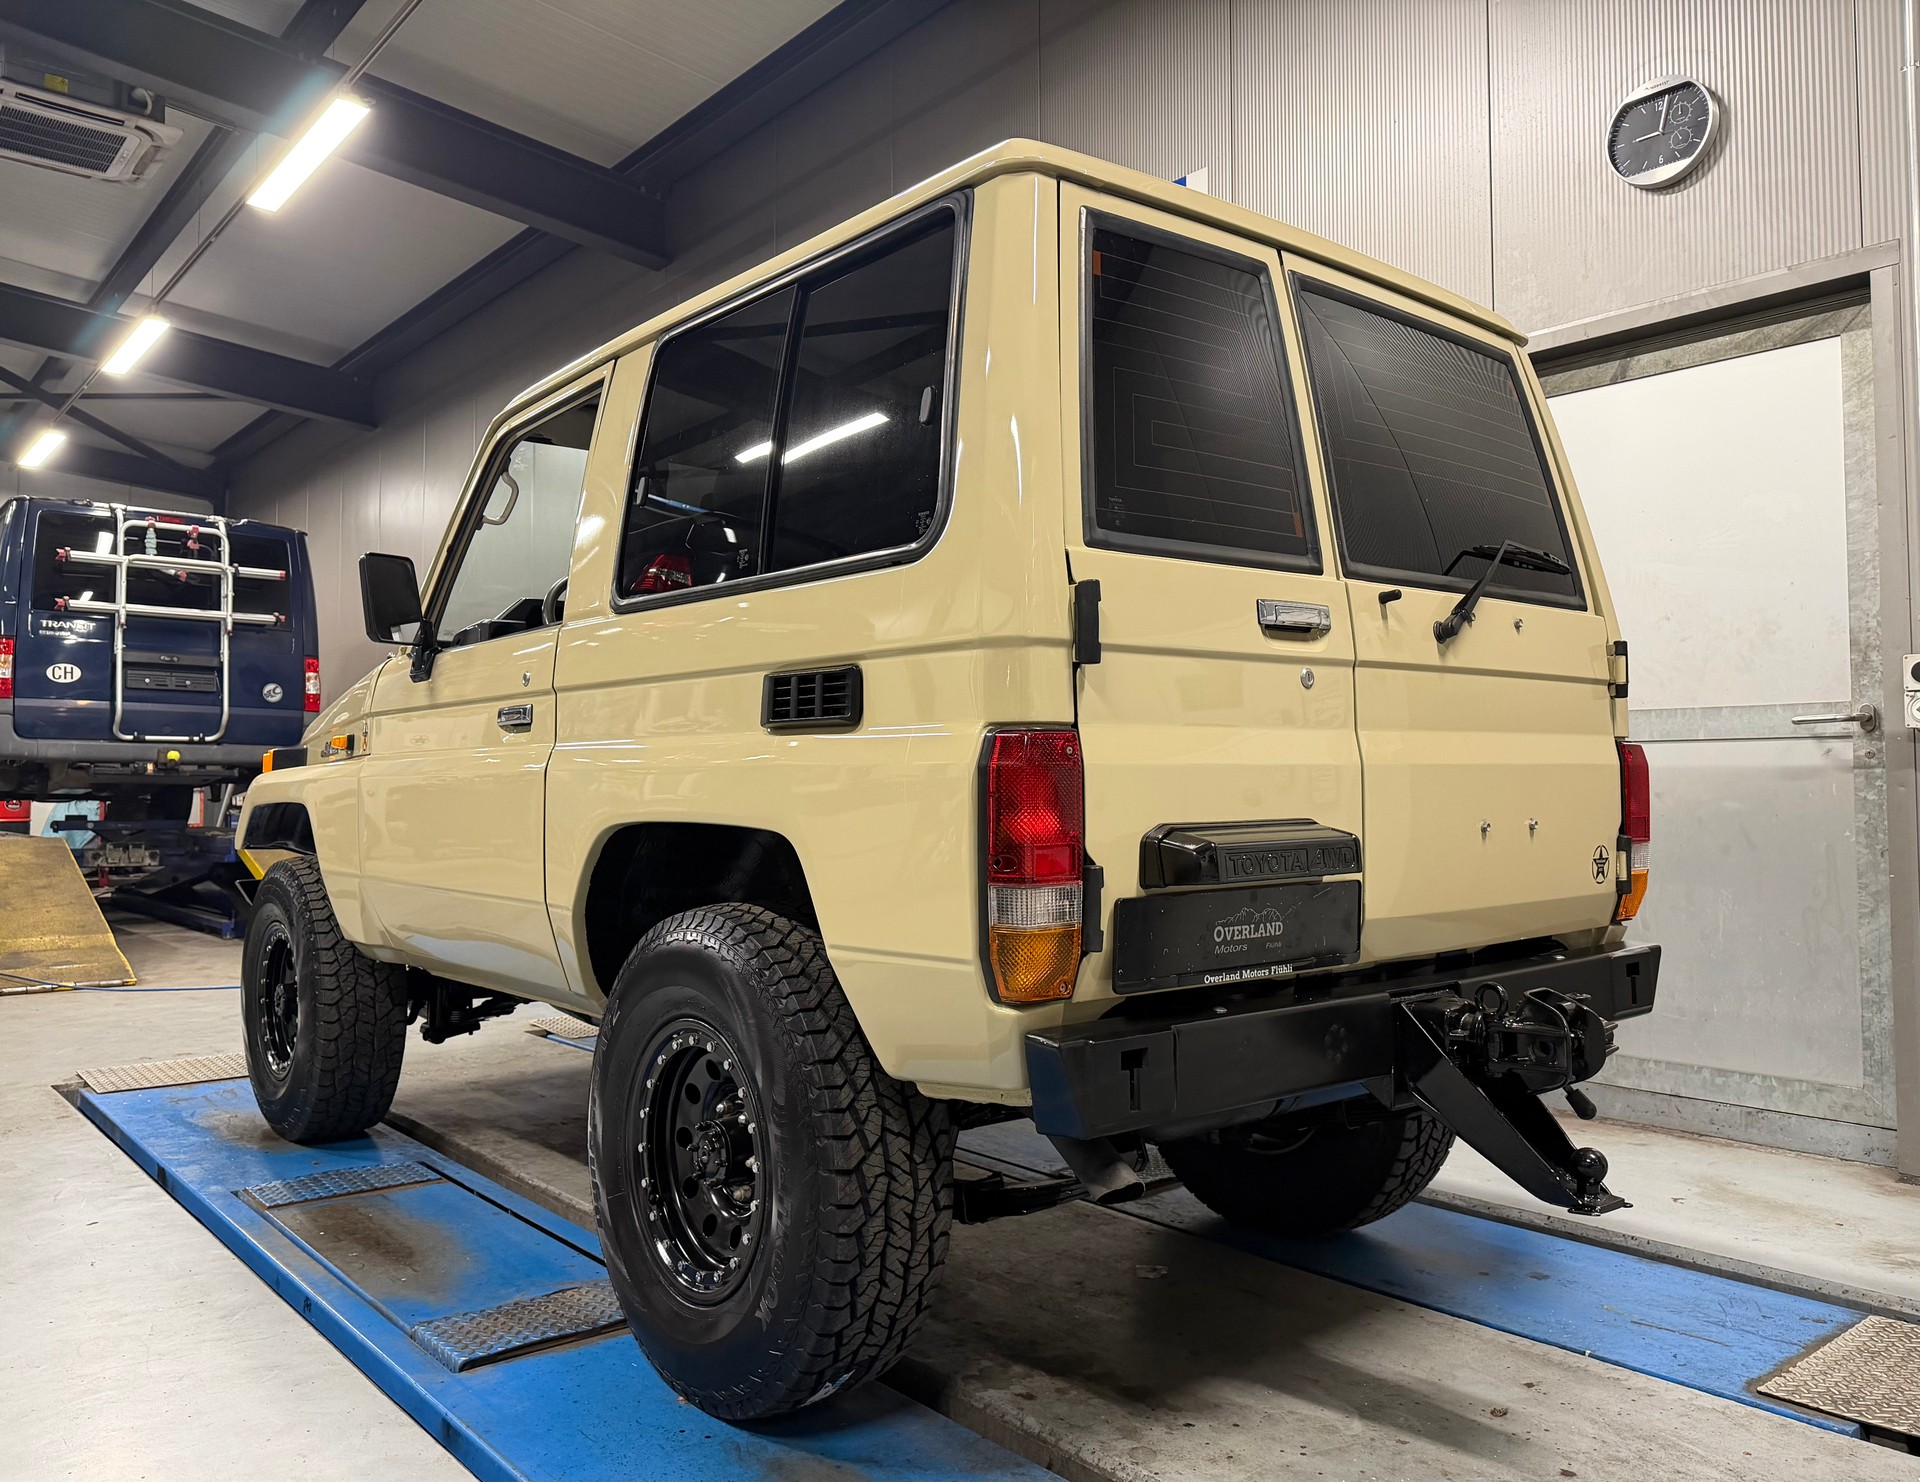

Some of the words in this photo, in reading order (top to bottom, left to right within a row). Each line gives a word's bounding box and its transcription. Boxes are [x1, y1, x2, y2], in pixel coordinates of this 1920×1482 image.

[1654, 100, 1665, 112] 12
[1658, 154, 1664, 164] 6
[52, 665, 74, 680] CH
[1229, 852, 1306, 876] TOYOTA
[1310, 846, 1356, 871] 4WD
[1213, 921, 1284, 943] OVERLAND
[1214, 943, 1248, 955] Motors
[1204, 972, 1241, 984] Overland
[1242, 968, 1269, 980] Motors
[1271, 964, 1293, 976] Flühli
